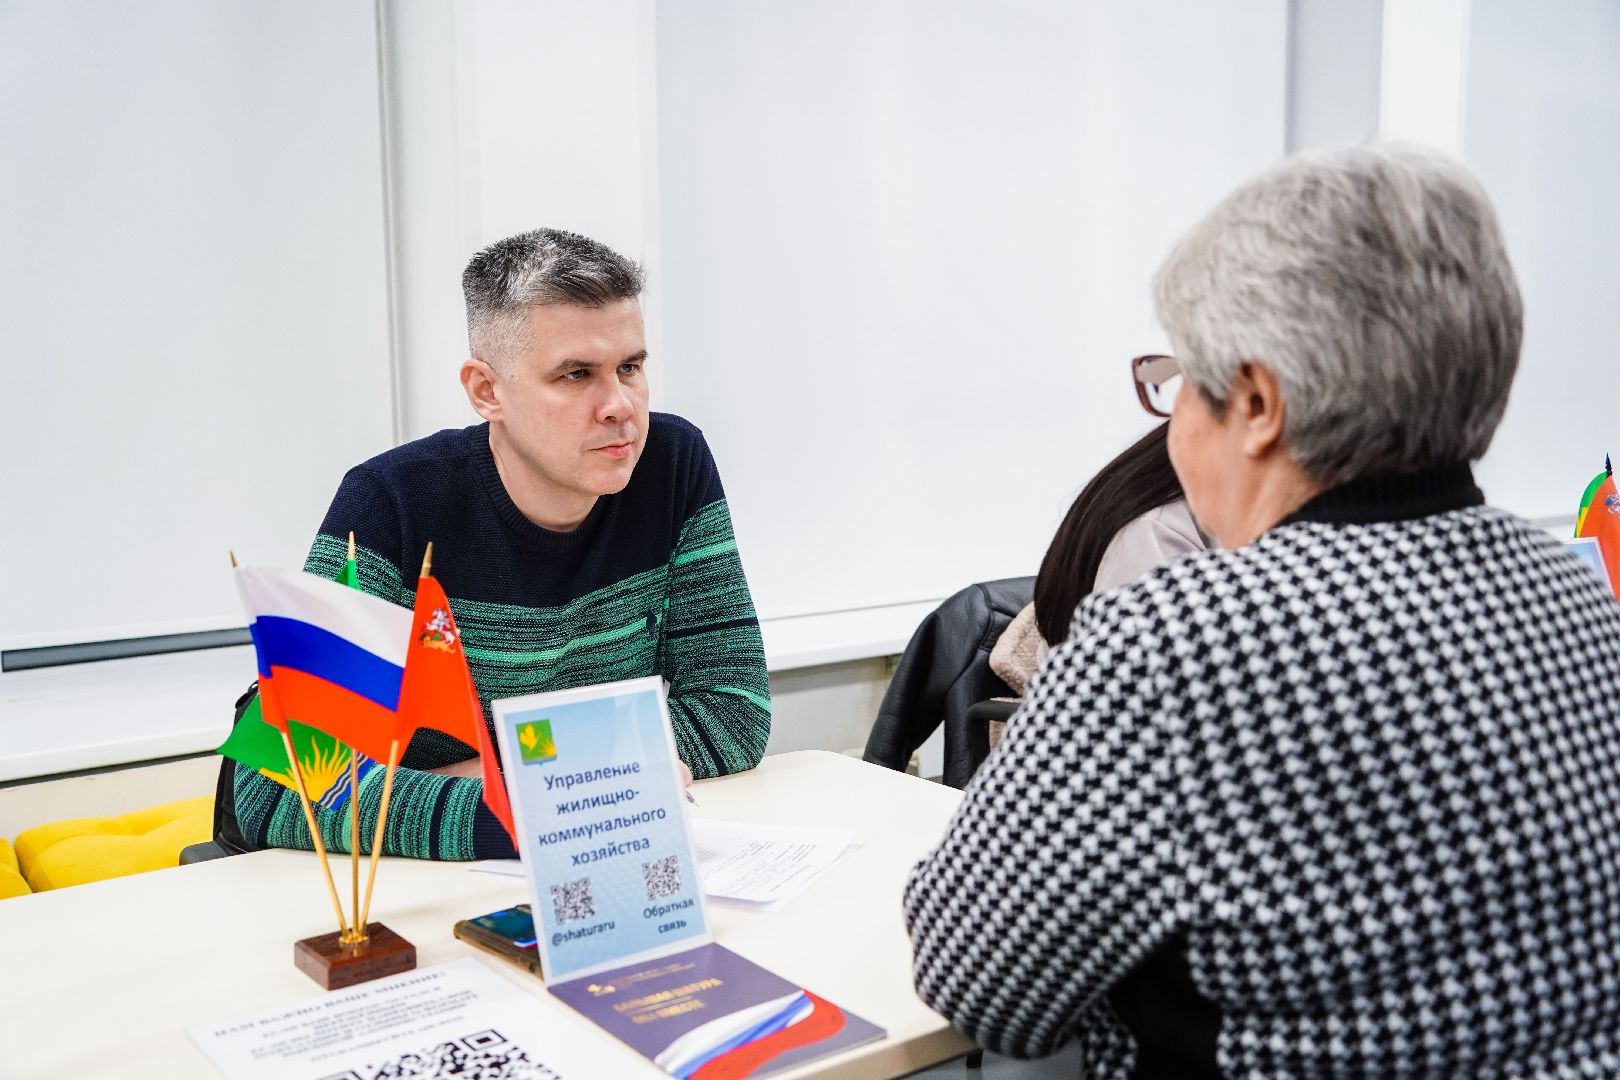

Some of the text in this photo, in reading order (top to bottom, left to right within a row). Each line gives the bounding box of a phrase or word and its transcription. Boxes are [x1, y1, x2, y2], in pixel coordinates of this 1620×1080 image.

[544, 762, 641, 790] Управление
[556, 789, 641, 815] жилищно-
[538, 808, 666, 847] коммунального
[571, 838, 650, 866] хозяйства
[643, 899, 694, 919] Обратная
[551, 921, 616, 947] @shaturaru
[658, 920, 687, 934] связь
